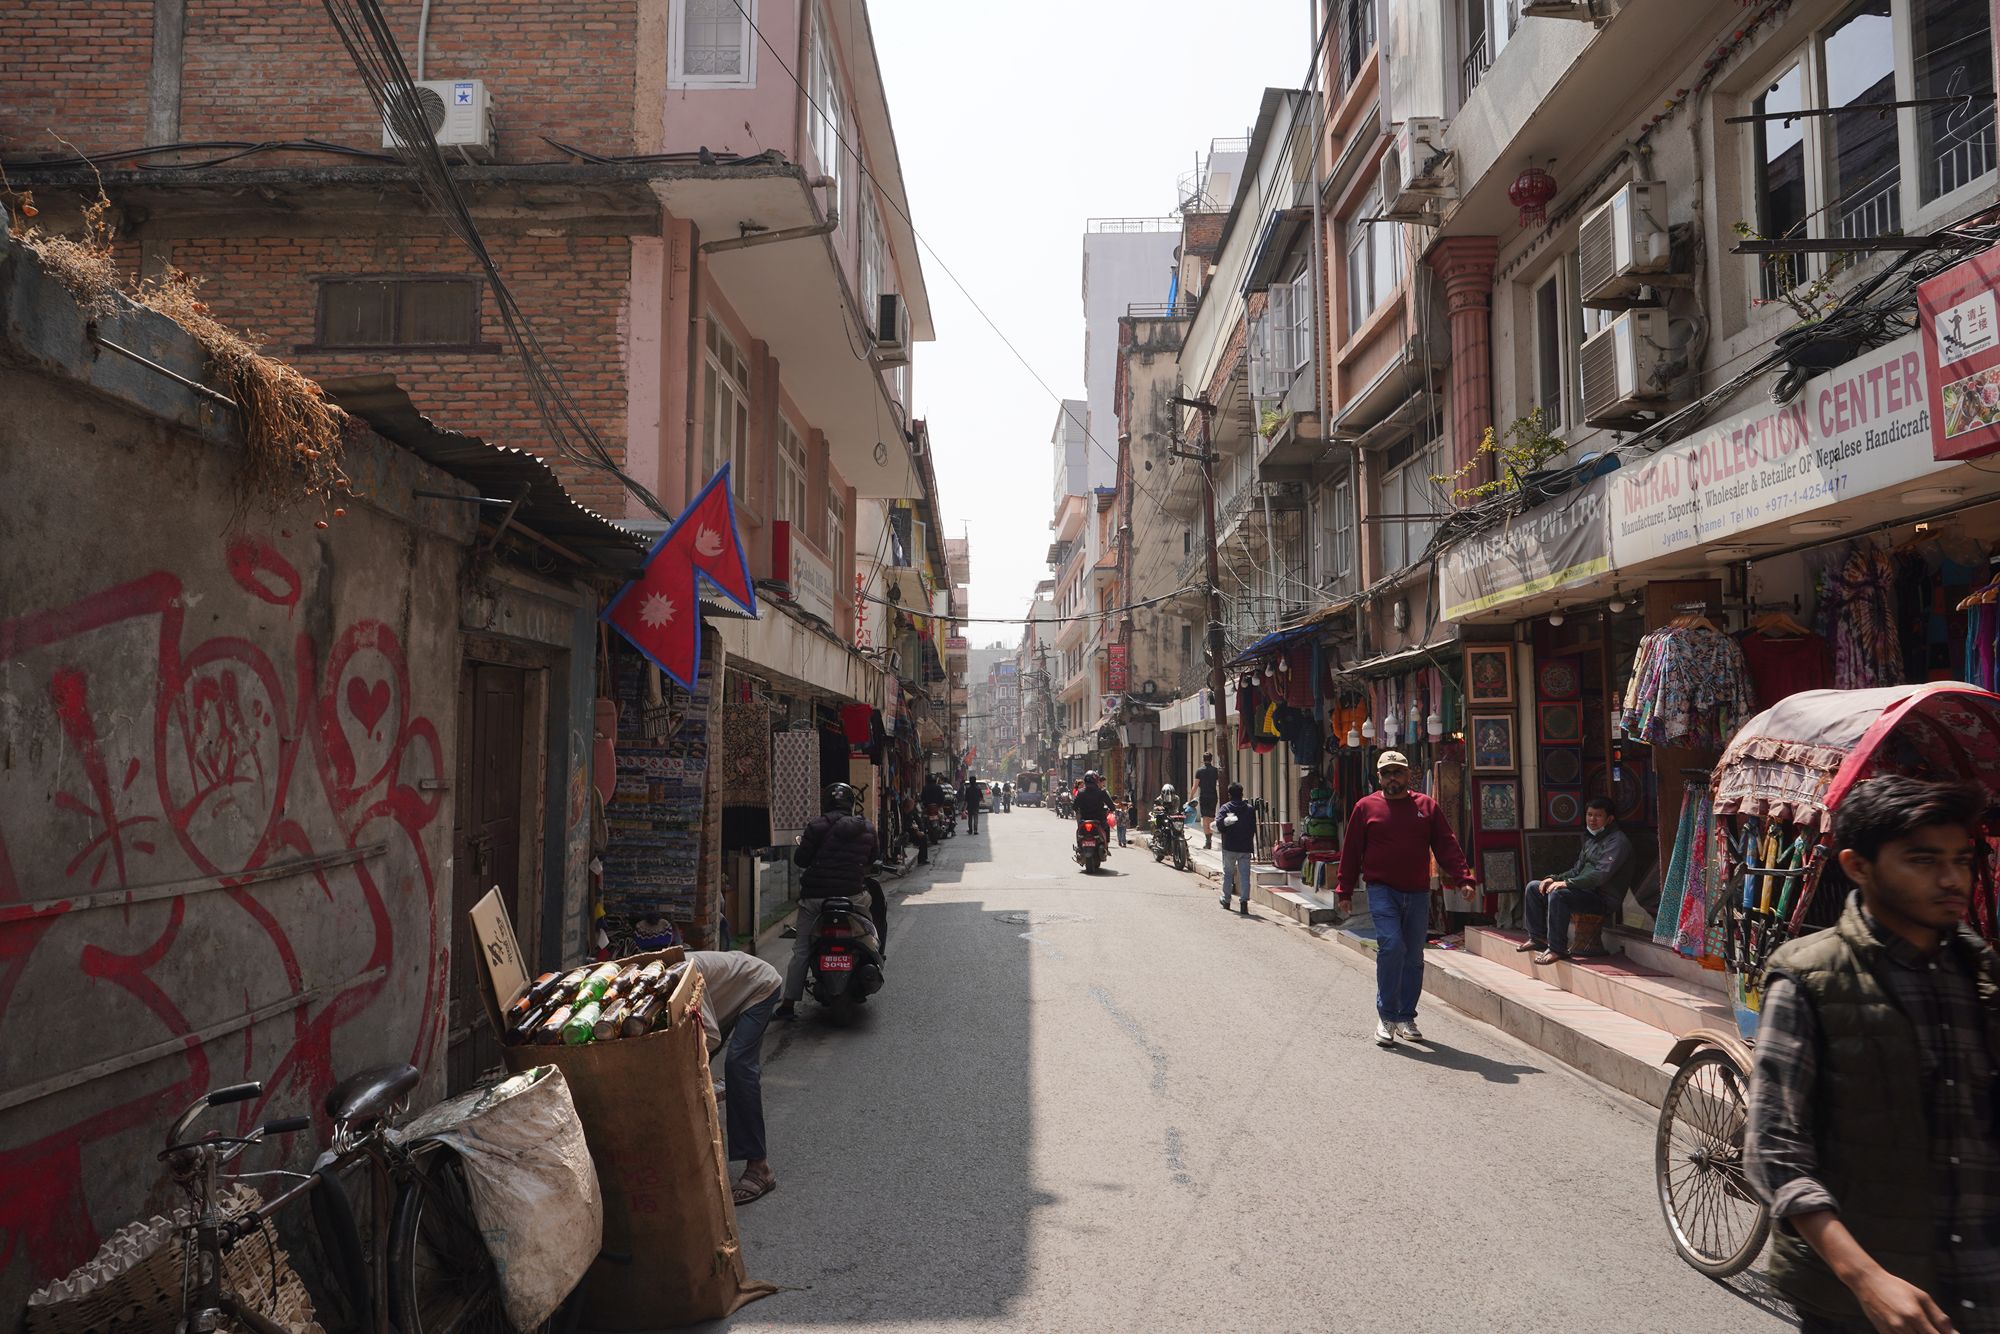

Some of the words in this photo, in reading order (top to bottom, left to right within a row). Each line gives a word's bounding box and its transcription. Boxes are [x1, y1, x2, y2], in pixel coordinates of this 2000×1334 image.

[1621, 512, 1667, 537] Manufacturer,
[1667, 499, 1703, 523] Exporter,
[1705, 479, 1749, 507] Wholesaler
[1751, 474, 1758, 492] &
[1760, 461, 1797, 489] Retailer
[1816, 440, 1862, 469] Nepalese
[1865, 410, 1930, 451] Handicraft
[1624, 458, 1680, 516] NATRAJ
[1687, 402, 1809, 492] COLLECTION
[1818, 350, 1923, 438] CENTER
[1541, 508, 1567, 543] PVT.
[1571, 494, 1600, 529] LTD.
[1730, 509, 1744, 524] Tel
[1746, 506, 1759, 518] No
